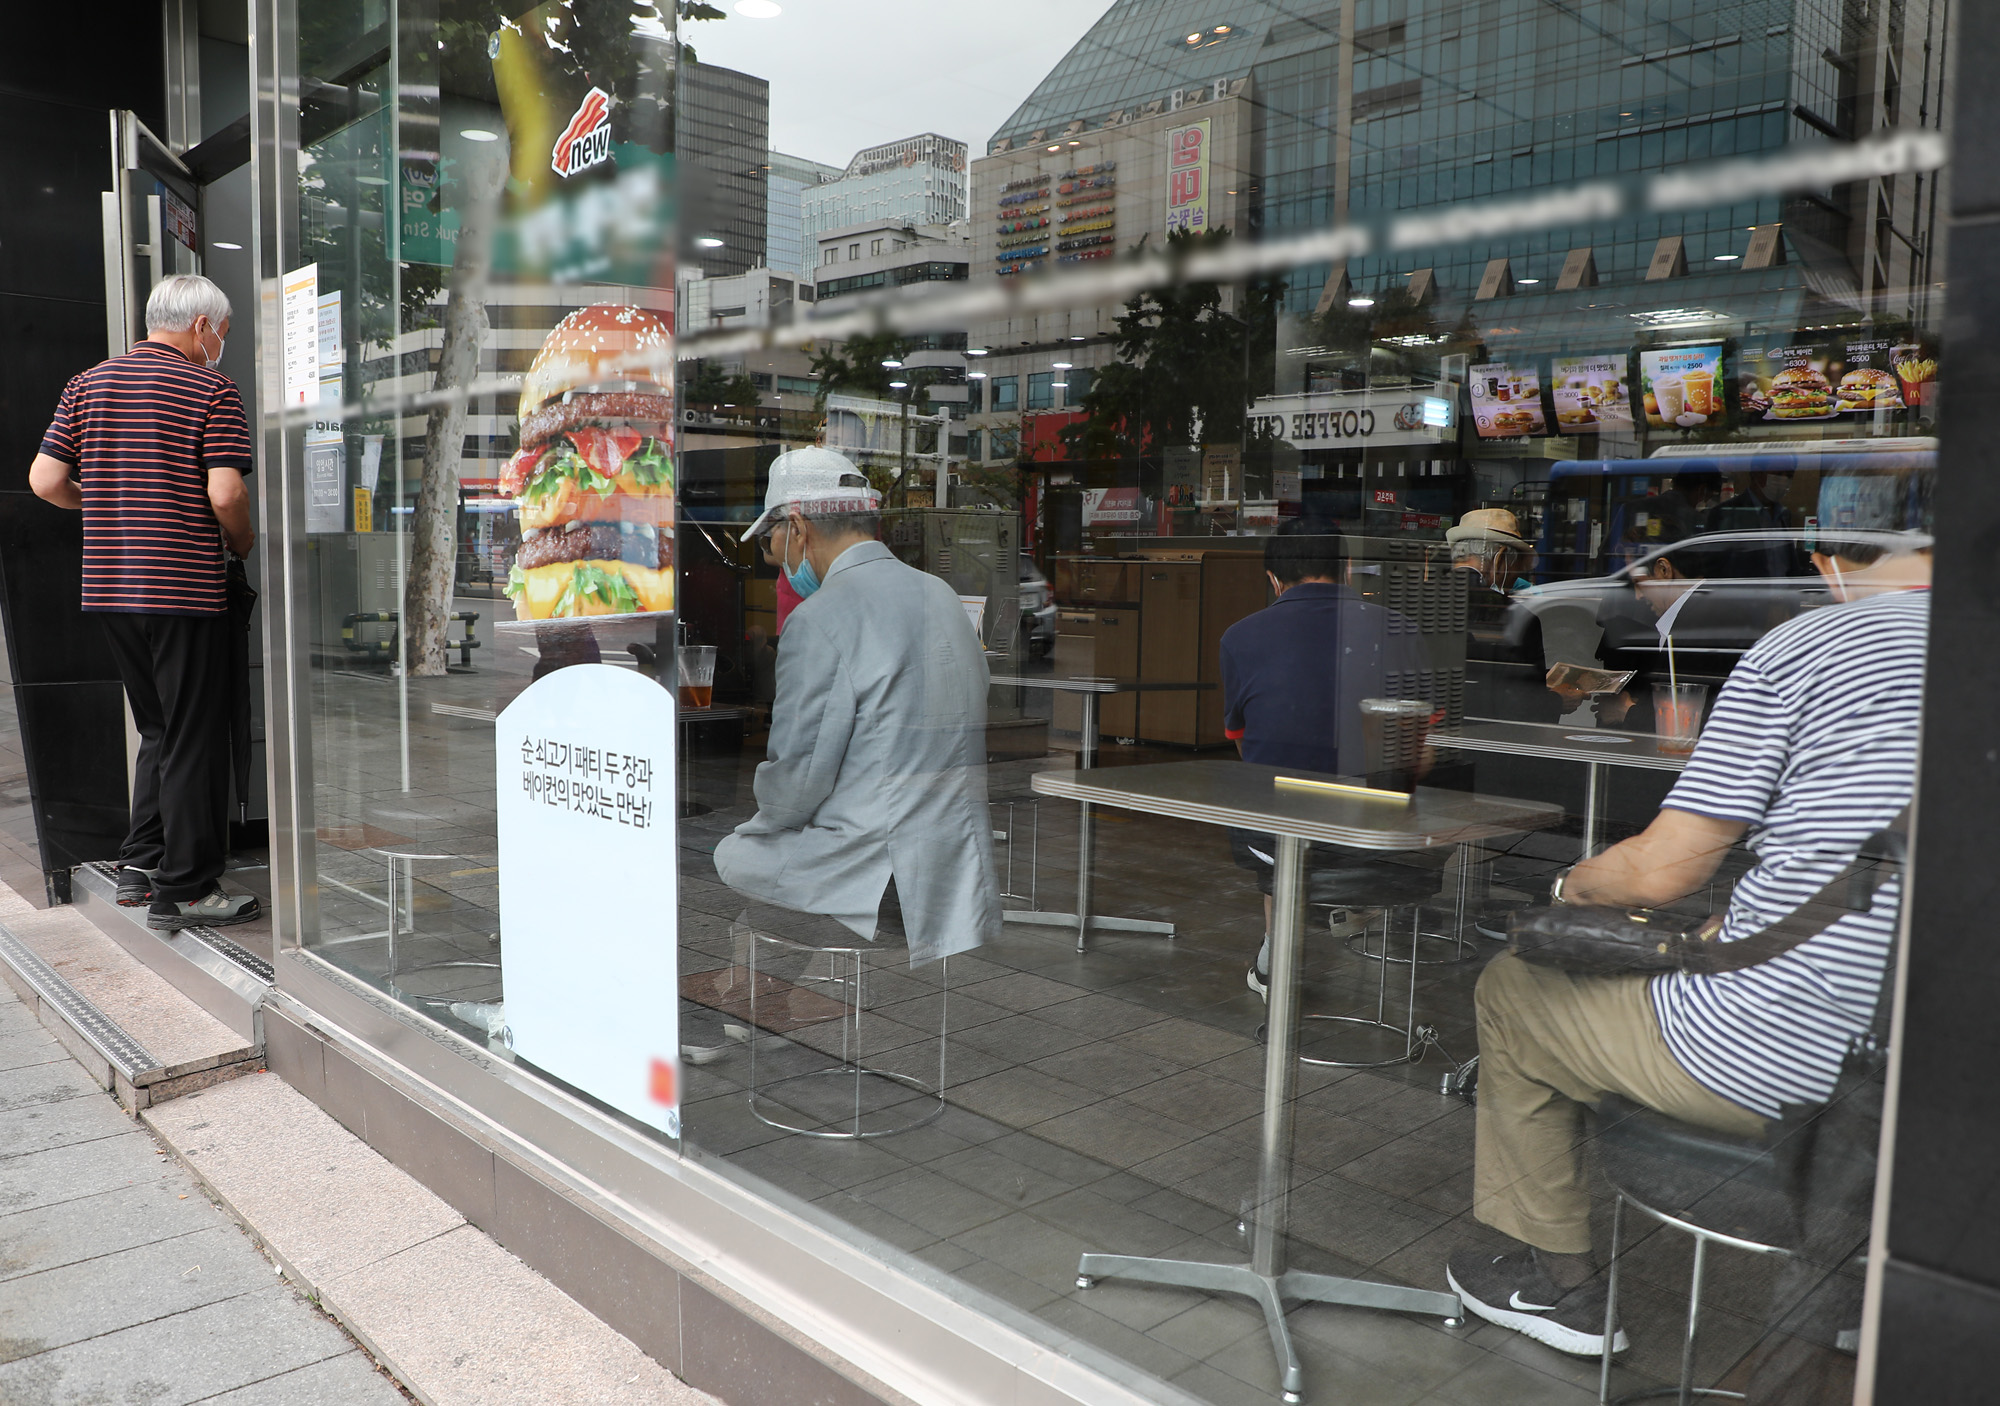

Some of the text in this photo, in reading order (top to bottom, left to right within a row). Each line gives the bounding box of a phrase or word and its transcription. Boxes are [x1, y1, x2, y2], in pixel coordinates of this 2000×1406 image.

[571, 128, 609, 170] new
[1789, 359, 1807, 367] 6300
[1851, 355, 1870, 363] 6500
[1589, 364, 1596, 372] 더
[1597, 362, 1617, 372] 맛있게!
[1480, 417, 1487, 425] 2
[574, 746, 602, 781] 패티
[604, 752, 620, 784] 두
[622, 755, 653, 792] 장과
[523, 770, 652, 829] 베이컨의 맛있는 만남!
